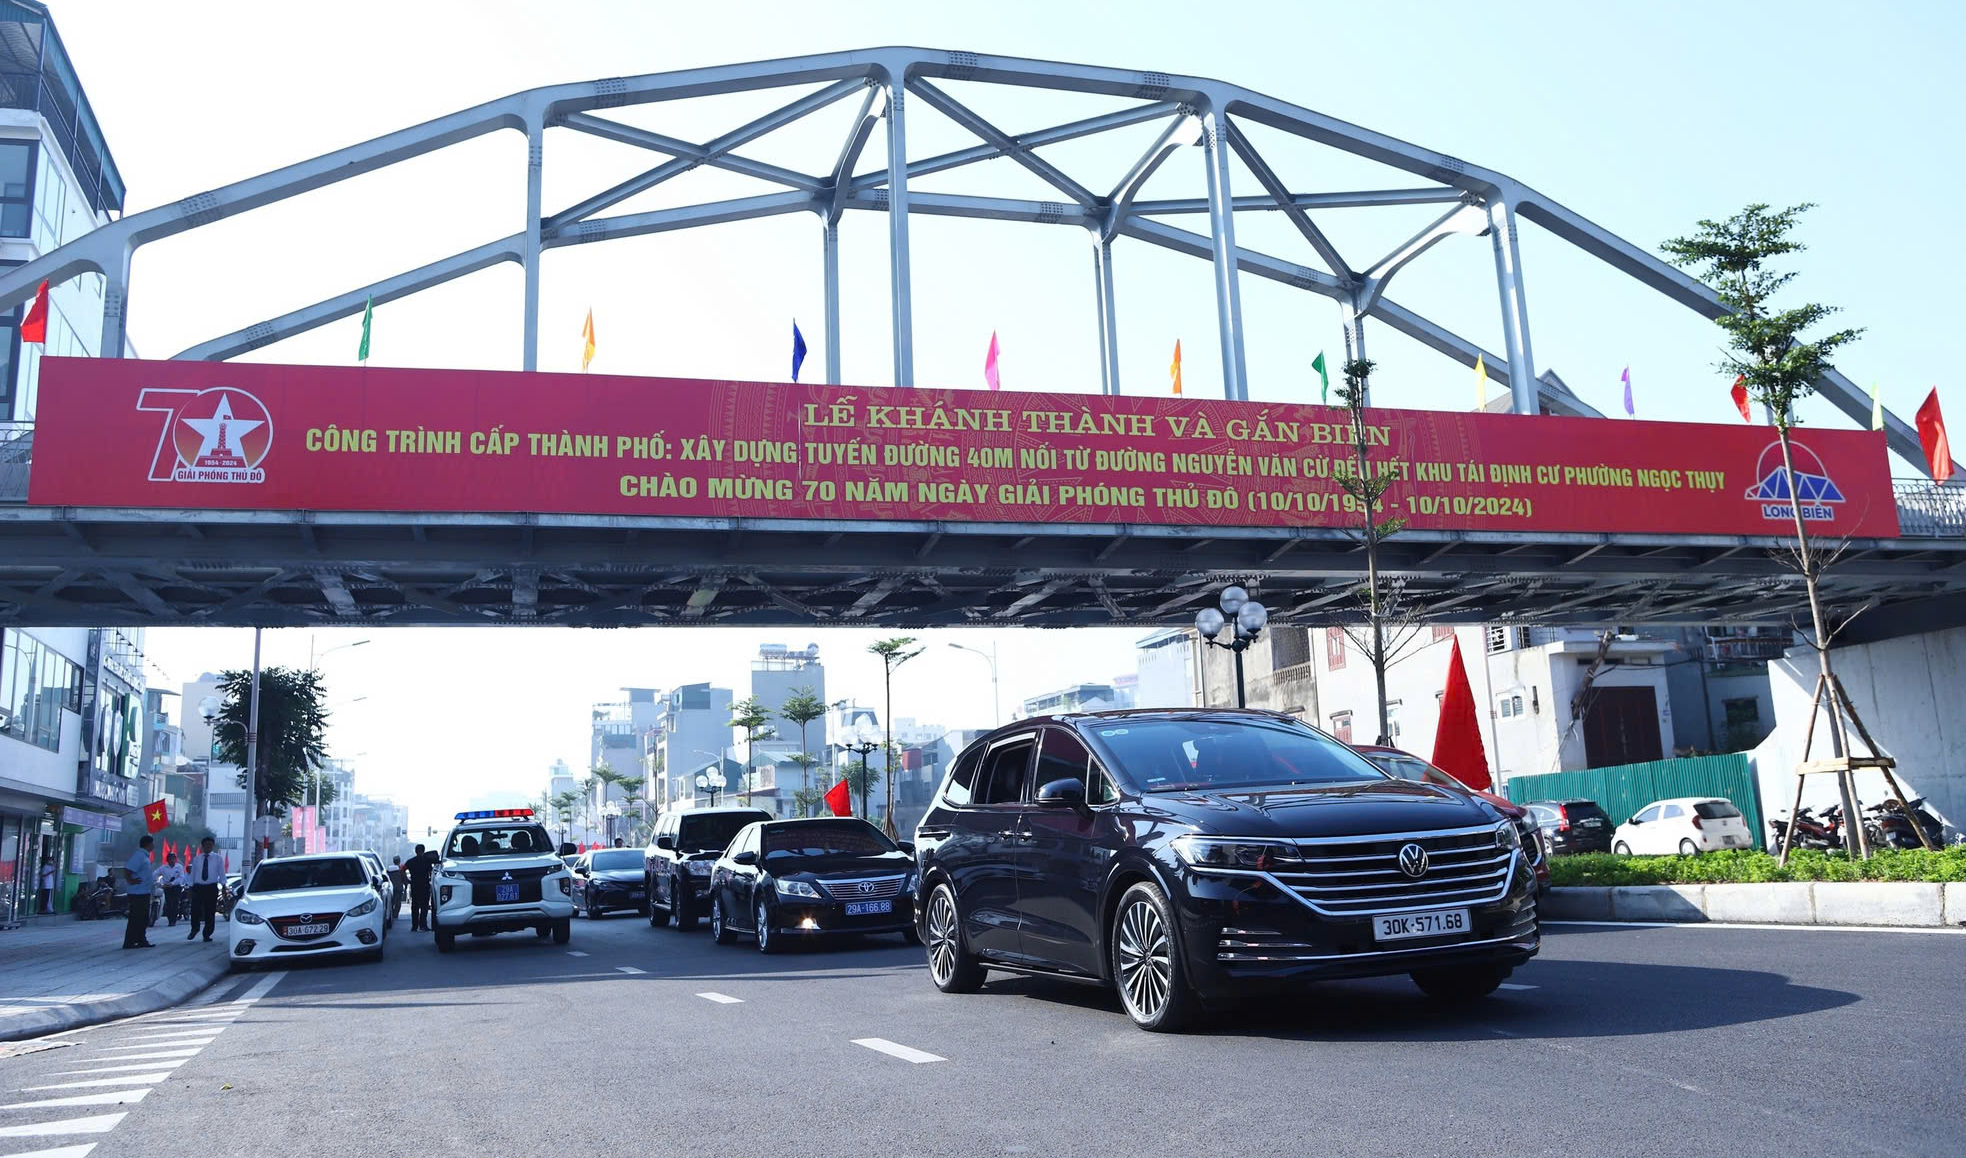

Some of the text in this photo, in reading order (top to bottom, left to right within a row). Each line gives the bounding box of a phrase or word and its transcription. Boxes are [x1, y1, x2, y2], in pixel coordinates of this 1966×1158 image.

[804, 396, 858, 427] LỄ
[866, 401, 1013, 432] KHÁNH
[1022, 406, 1156, 437] THÀNH
[1165, 411, 1217, 440] VÀ
[1225, 408, 1300, 443] GẮN
[305, 424, 377, 453] CÔNG
[386, 426, 461, 454] TRÌNH
[470, 425, 520, 456] CẤP
[528, 429, 608, 458] THÀNH
[617, 430, 672, 461] PHỐ:
[680, 434, 726, 461] XÂY
[733, 438, 797, 467] DỰNG
[805, 437, 877, 466] TUYẾN
[883, 440, 960, 467] ĐƯỜNG
[967, 446, 1013, 469] 40M
[1020, 441, 1057, 471] NỐI
[1063, 446, 1090, 471] TỪ
[1095, 448, 1166, 473] ĐƯỜNG
[1172, 449, 1252, 476] NGUYỄN
[1259, 454, 1298, 478] VĂN
[1303, 455, 1329, 479] CỪ
[1376, 455, 1410, 482] HẾT
[1416, 461, 1452, 483] KHU
[1456, 459, 1485, 483] TÁI
[1489, 464, 1532, 488] ĐỊNH
[1536, 464, 1560, 485] CƯ
[1564, 463, 1634, 487] PHƯỜNG
[1637, 468, 1682, 492] NGỌC
[1685, 470, 1725, 493] THỤY
[177, 468, 263, 481] GIẢI PHÓNG THỦ ĐÔ
[619, 472, 698, 498] CHÀO
[707, 473, 793, 501] MỪNG
[802, 480, 836, 502] 70
[845, 477, 909, 503] NĂM
[918, 480, 990, 504] NGÀY
[998, 479, 1051, 506] GIẢI
[1058, 482, 1146, 507] PHÓNG
[1152, 482, 1201, 508] THỦ
[1207, 487, 1239, 510] ĐÔ
[1406, 496, 1533, 518] 10/10/2024)
[1802, 504, 1833, 519] BIÊN
[847, 902, 890, 914] 29A-166.88
[1383, 913, 1463, 936] 30K-571.68
